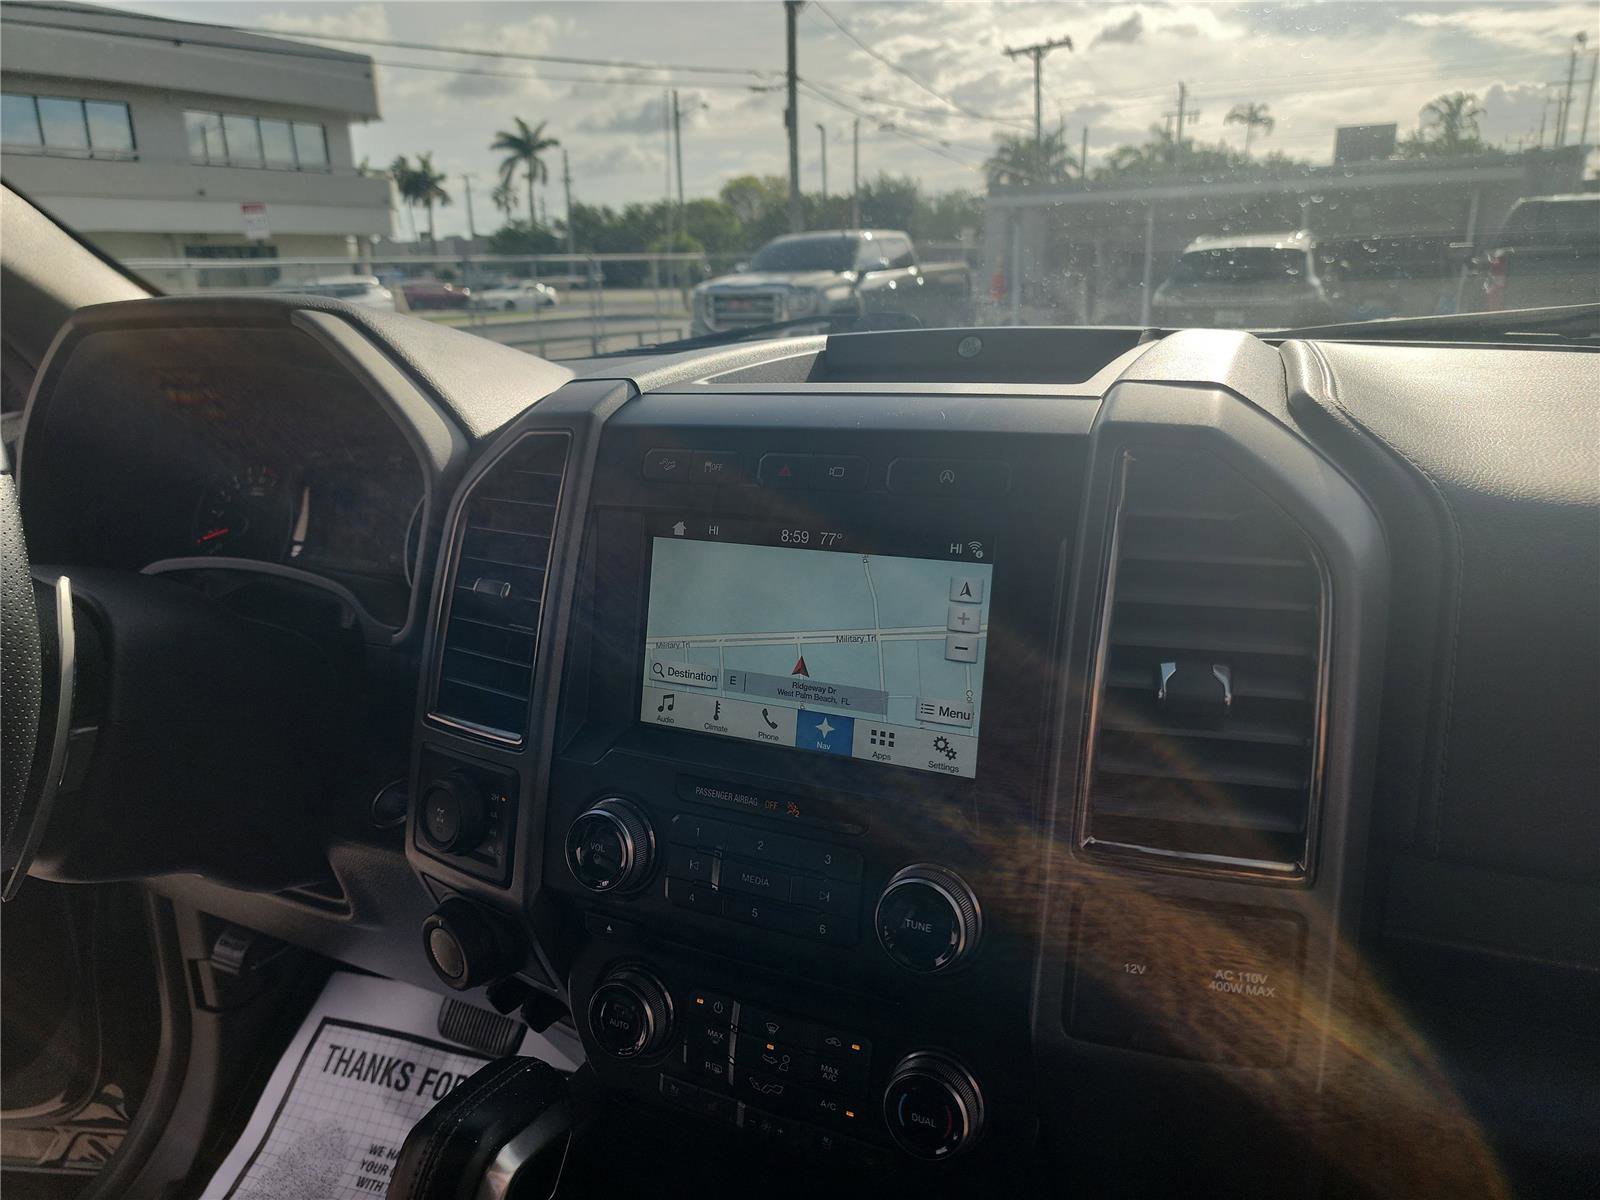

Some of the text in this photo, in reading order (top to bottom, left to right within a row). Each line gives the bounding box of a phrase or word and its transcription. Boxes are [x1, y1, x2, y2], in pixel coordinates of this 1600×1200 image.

[708, 525, 719, 535] HI
[780, 529, 810, 544] 8:59
[950, 543, 963, 554] HI
[836, 634, 865, 644] Military
[667, 667, 718, 683] Destination
[729, 675, 737, 685] E
[792, 681, 837, 695] Ridgeway Dr
[777, 688, 794, 698] West
[796, 690, 813, 700] Palm
[841, 697, 851, 706] FL
[656, 715, 675, 724] Audio
[938, 706, 971, 721] Menu
[703, 722, 729, 733] Climate
[757, 731, 780, 742] Phone
[816, 741, 832, 750] Nav
[871, 751, 892, 761] Apps
[927, 760, 960, 773] Settings
[695, 786, 733, 801] PASSENGER
[734, 793, 758, 807] AIRBAG
[757, 840, 765, 850] 2
[823, 854, 833, 865] 3
[741, 873, 770, 887] MEDIA
[751, 907, 759, 918] 5
[818, 923, 827, 935] 6
[905, 918, 933, 934] TUNE
[1123, 963, 1147, 975] 12V
[1215, 969, 1269, 985] AC 110V
[1208, 981, 1277, 998] 400W MAX
[608, 1017, 630, 1031] AUTO
[707, 1028, 725, 1041] MAX
[322, 1043, 415, 1093] THANKS
[820, 1064, 840, 1076] MAX
[819, 1099, 838, 1111] A/C
[911, 1112, 937, 1129] DUAL
[369, 1143, 386, 1157] WE
[360, 1158, 389, 1176] YOUR
[356, 1175, 385, 1192] WITH
